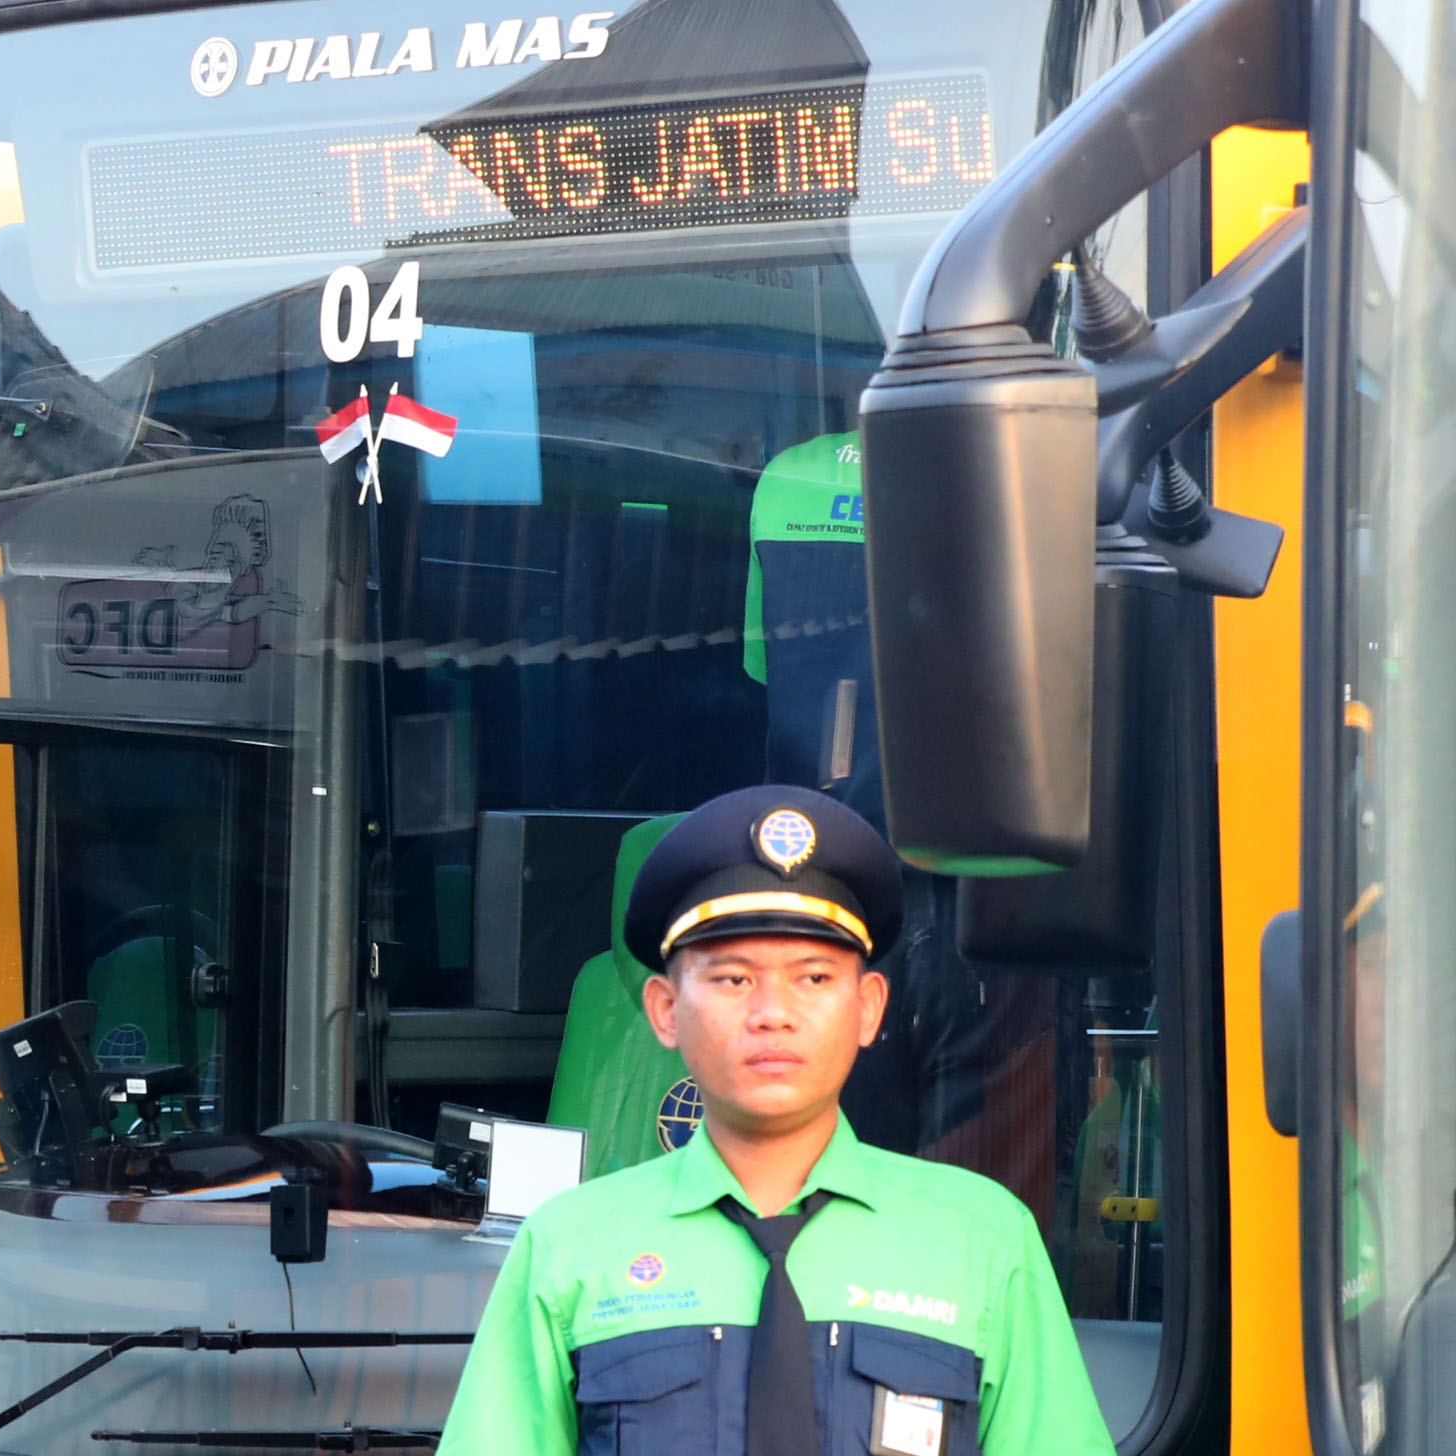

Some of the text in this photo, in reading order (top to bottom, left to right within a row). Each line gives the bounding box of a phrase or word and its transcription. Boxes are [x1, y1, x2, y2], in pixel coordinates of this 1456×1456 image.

[245, 12, 615, 86] PIALA MAS
[327, 124, 608, 224] TRANS
[631, 104, 856, 202] JATIM
[319, 261, 424, 363] 04
[872, 1288, 958, 1325] DAMRI
